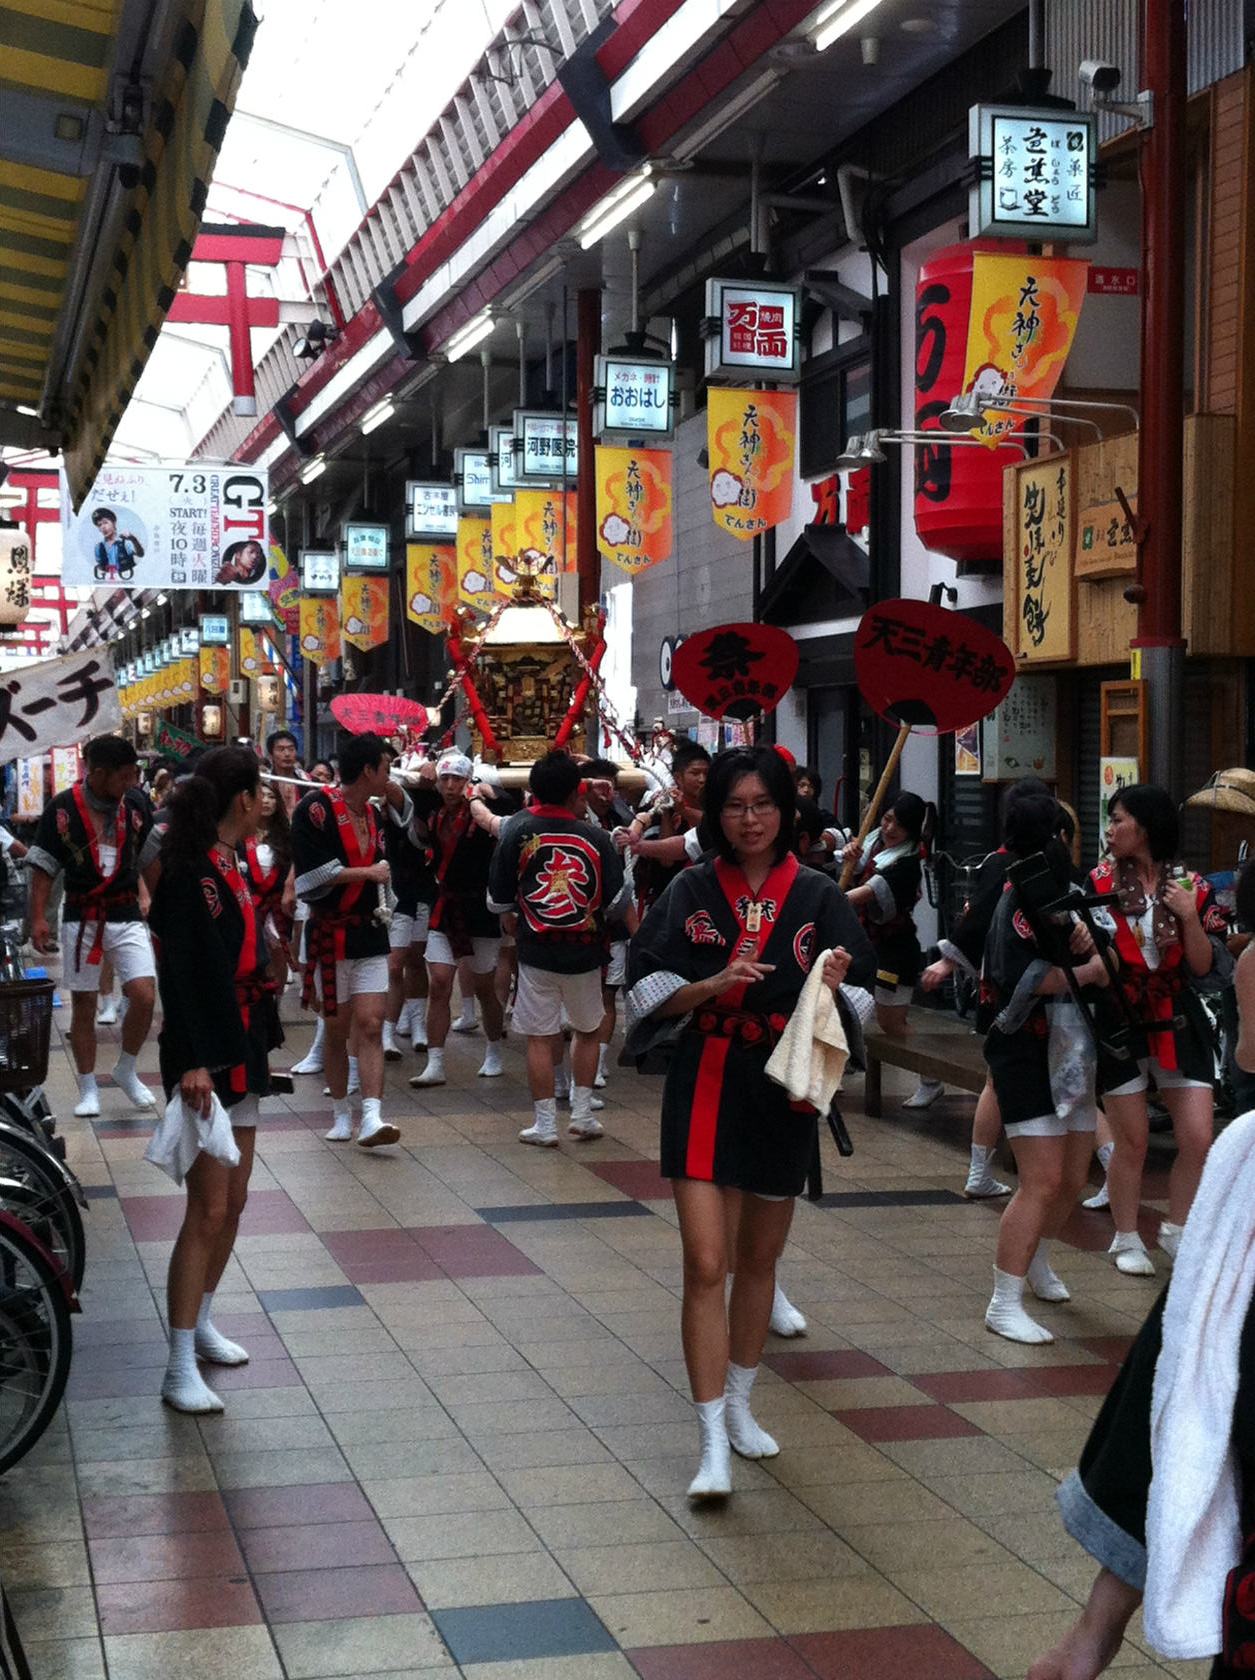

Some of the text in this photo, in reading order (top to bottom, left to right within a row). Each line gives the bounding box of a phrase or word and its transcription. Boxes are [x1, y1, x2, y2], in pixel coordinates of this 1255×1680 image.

[998, 136, 1018, 179] 茶房
[610, 386, 667, 409] おおはし
[527, 437, 576, 458] 河野医院
[169, 474, 207, 494] 7.3
[191, 521, 207, 584] 毎週火曜
[94, 566, 134, 582] GTO
[699, 631, 767, 681] 祭
